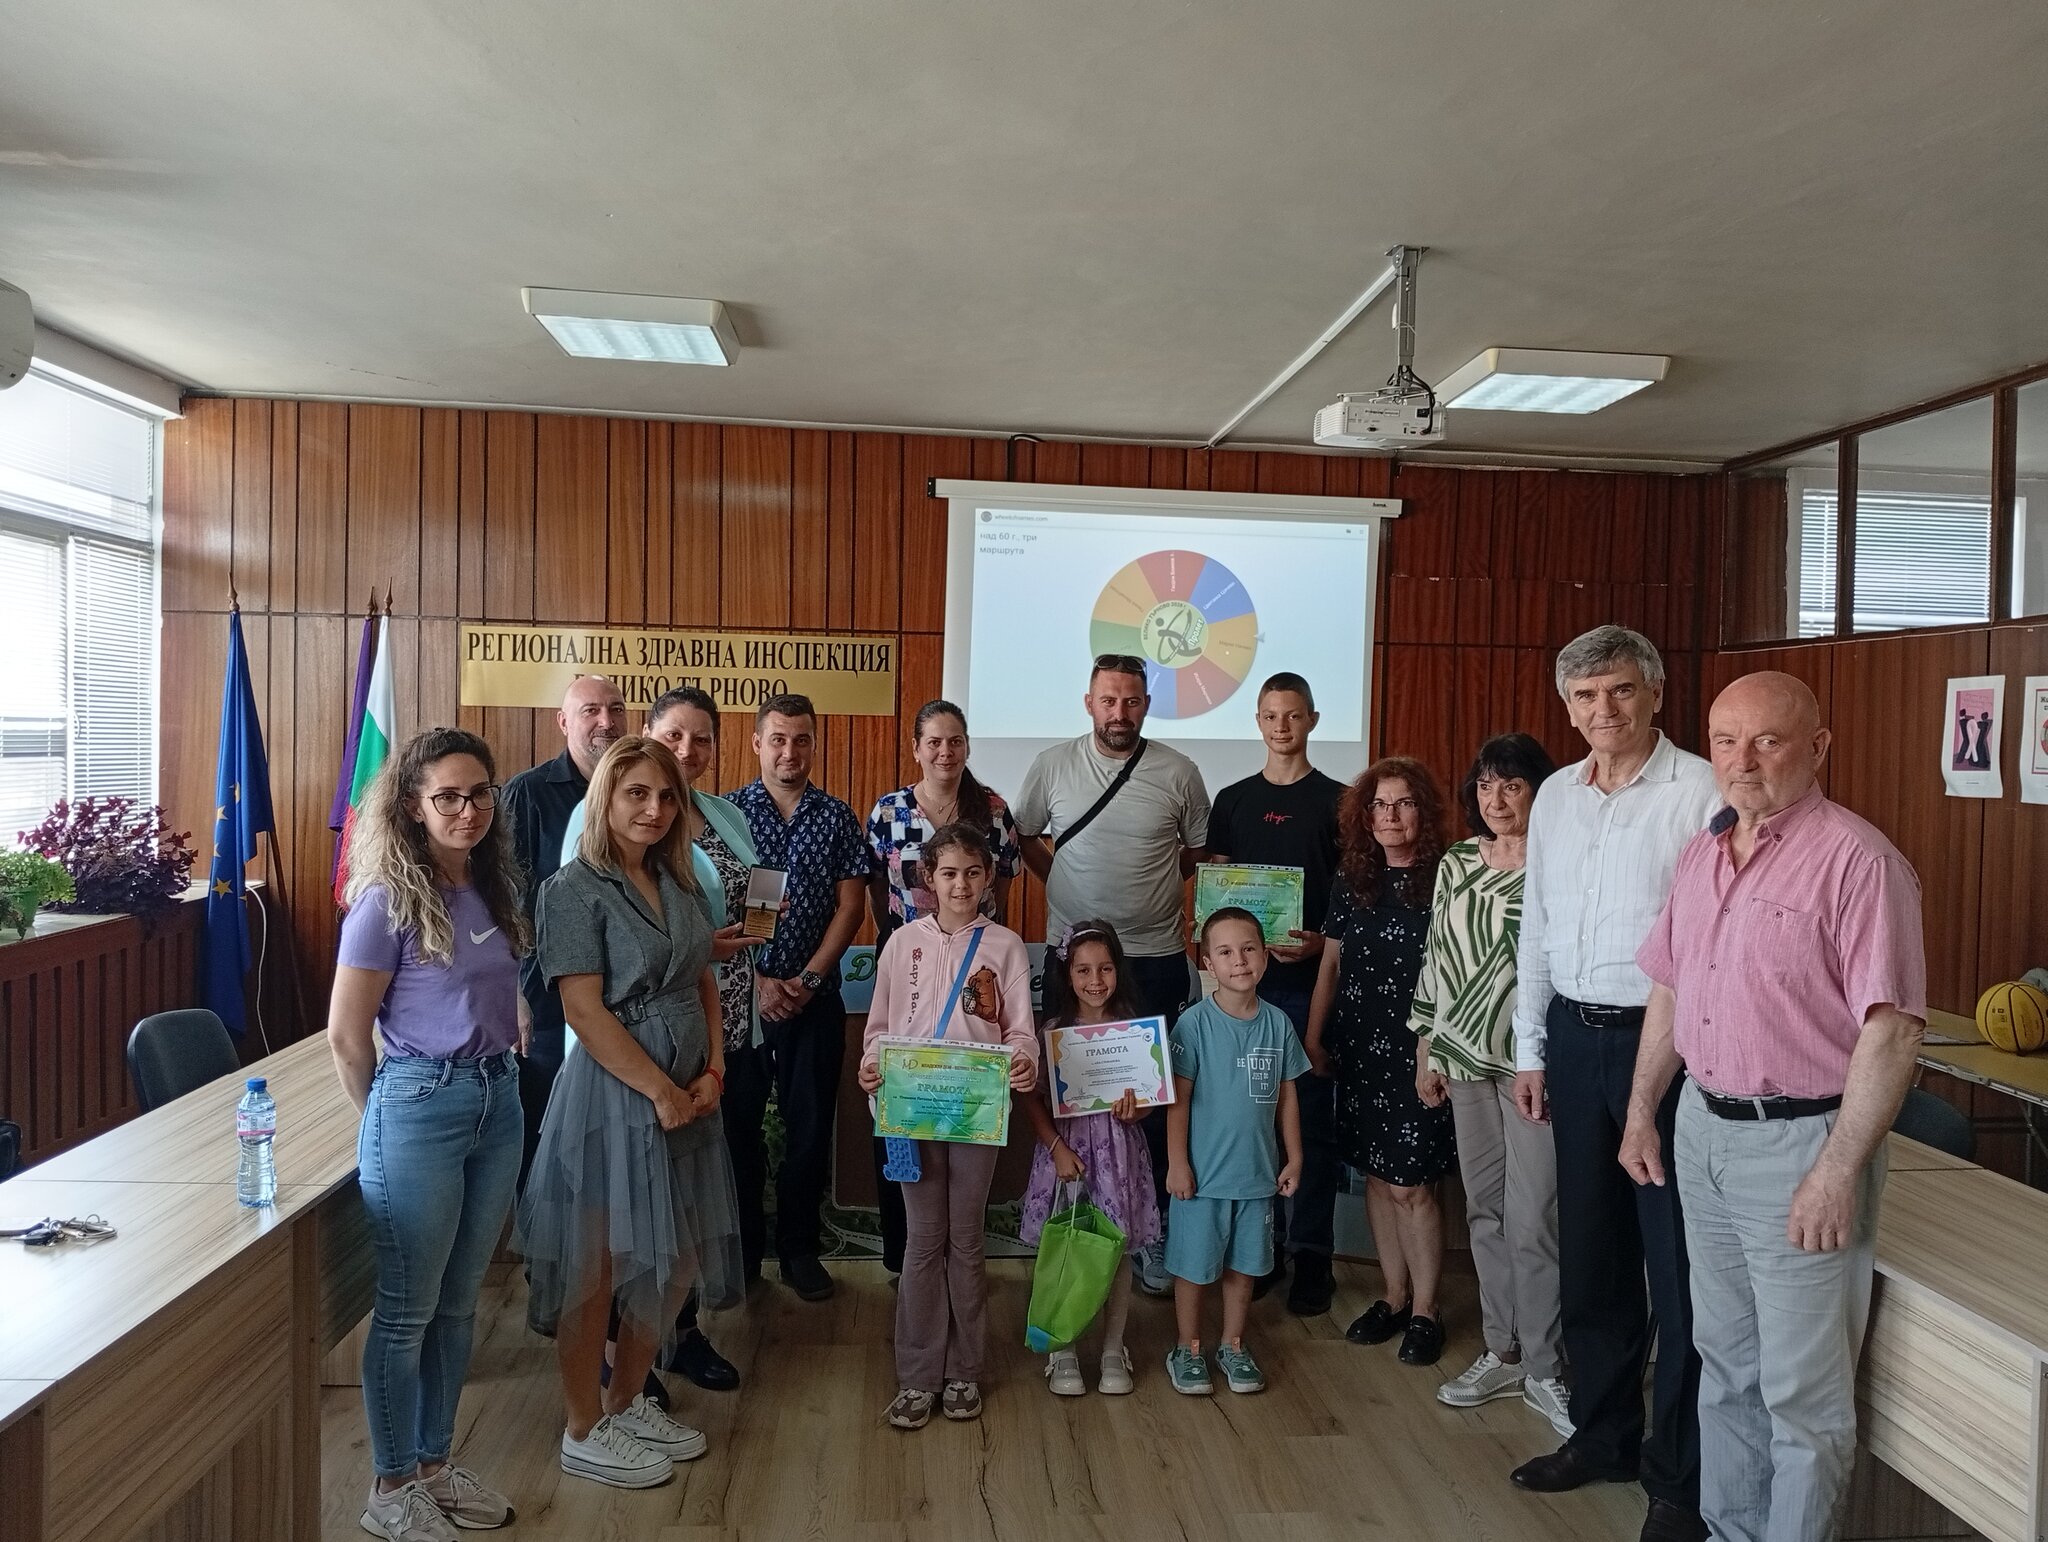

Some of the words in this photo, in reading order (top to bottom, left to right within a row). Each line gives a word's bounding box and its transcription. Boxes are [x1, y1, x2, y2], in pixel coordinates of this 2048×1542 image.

[980, 532, 997, 541] над
[999, 532, 1010, 540] 60
[1022, 534, 1037, 542] три
[980, 547, 1024, 556] маршрута
[1188, 618, 1205, 647] Пролет
[467, 632, 629, 665] РЕГИОНАЛНА
[636, 637, 738, 673] ЗДРАВНА
[744, 640, 891, 678] ИНСПЕКЦИЯ
[575, 674, 671, 704] ЛИКО
[1228, 897, 1272, 907] ГРАМОТА
[908, 992, 920, 1024] Bara
[1085, 1045, 1129, 1057] ГРАМОТА
[917, 1083, 973, 1096] ГРАМОТА
